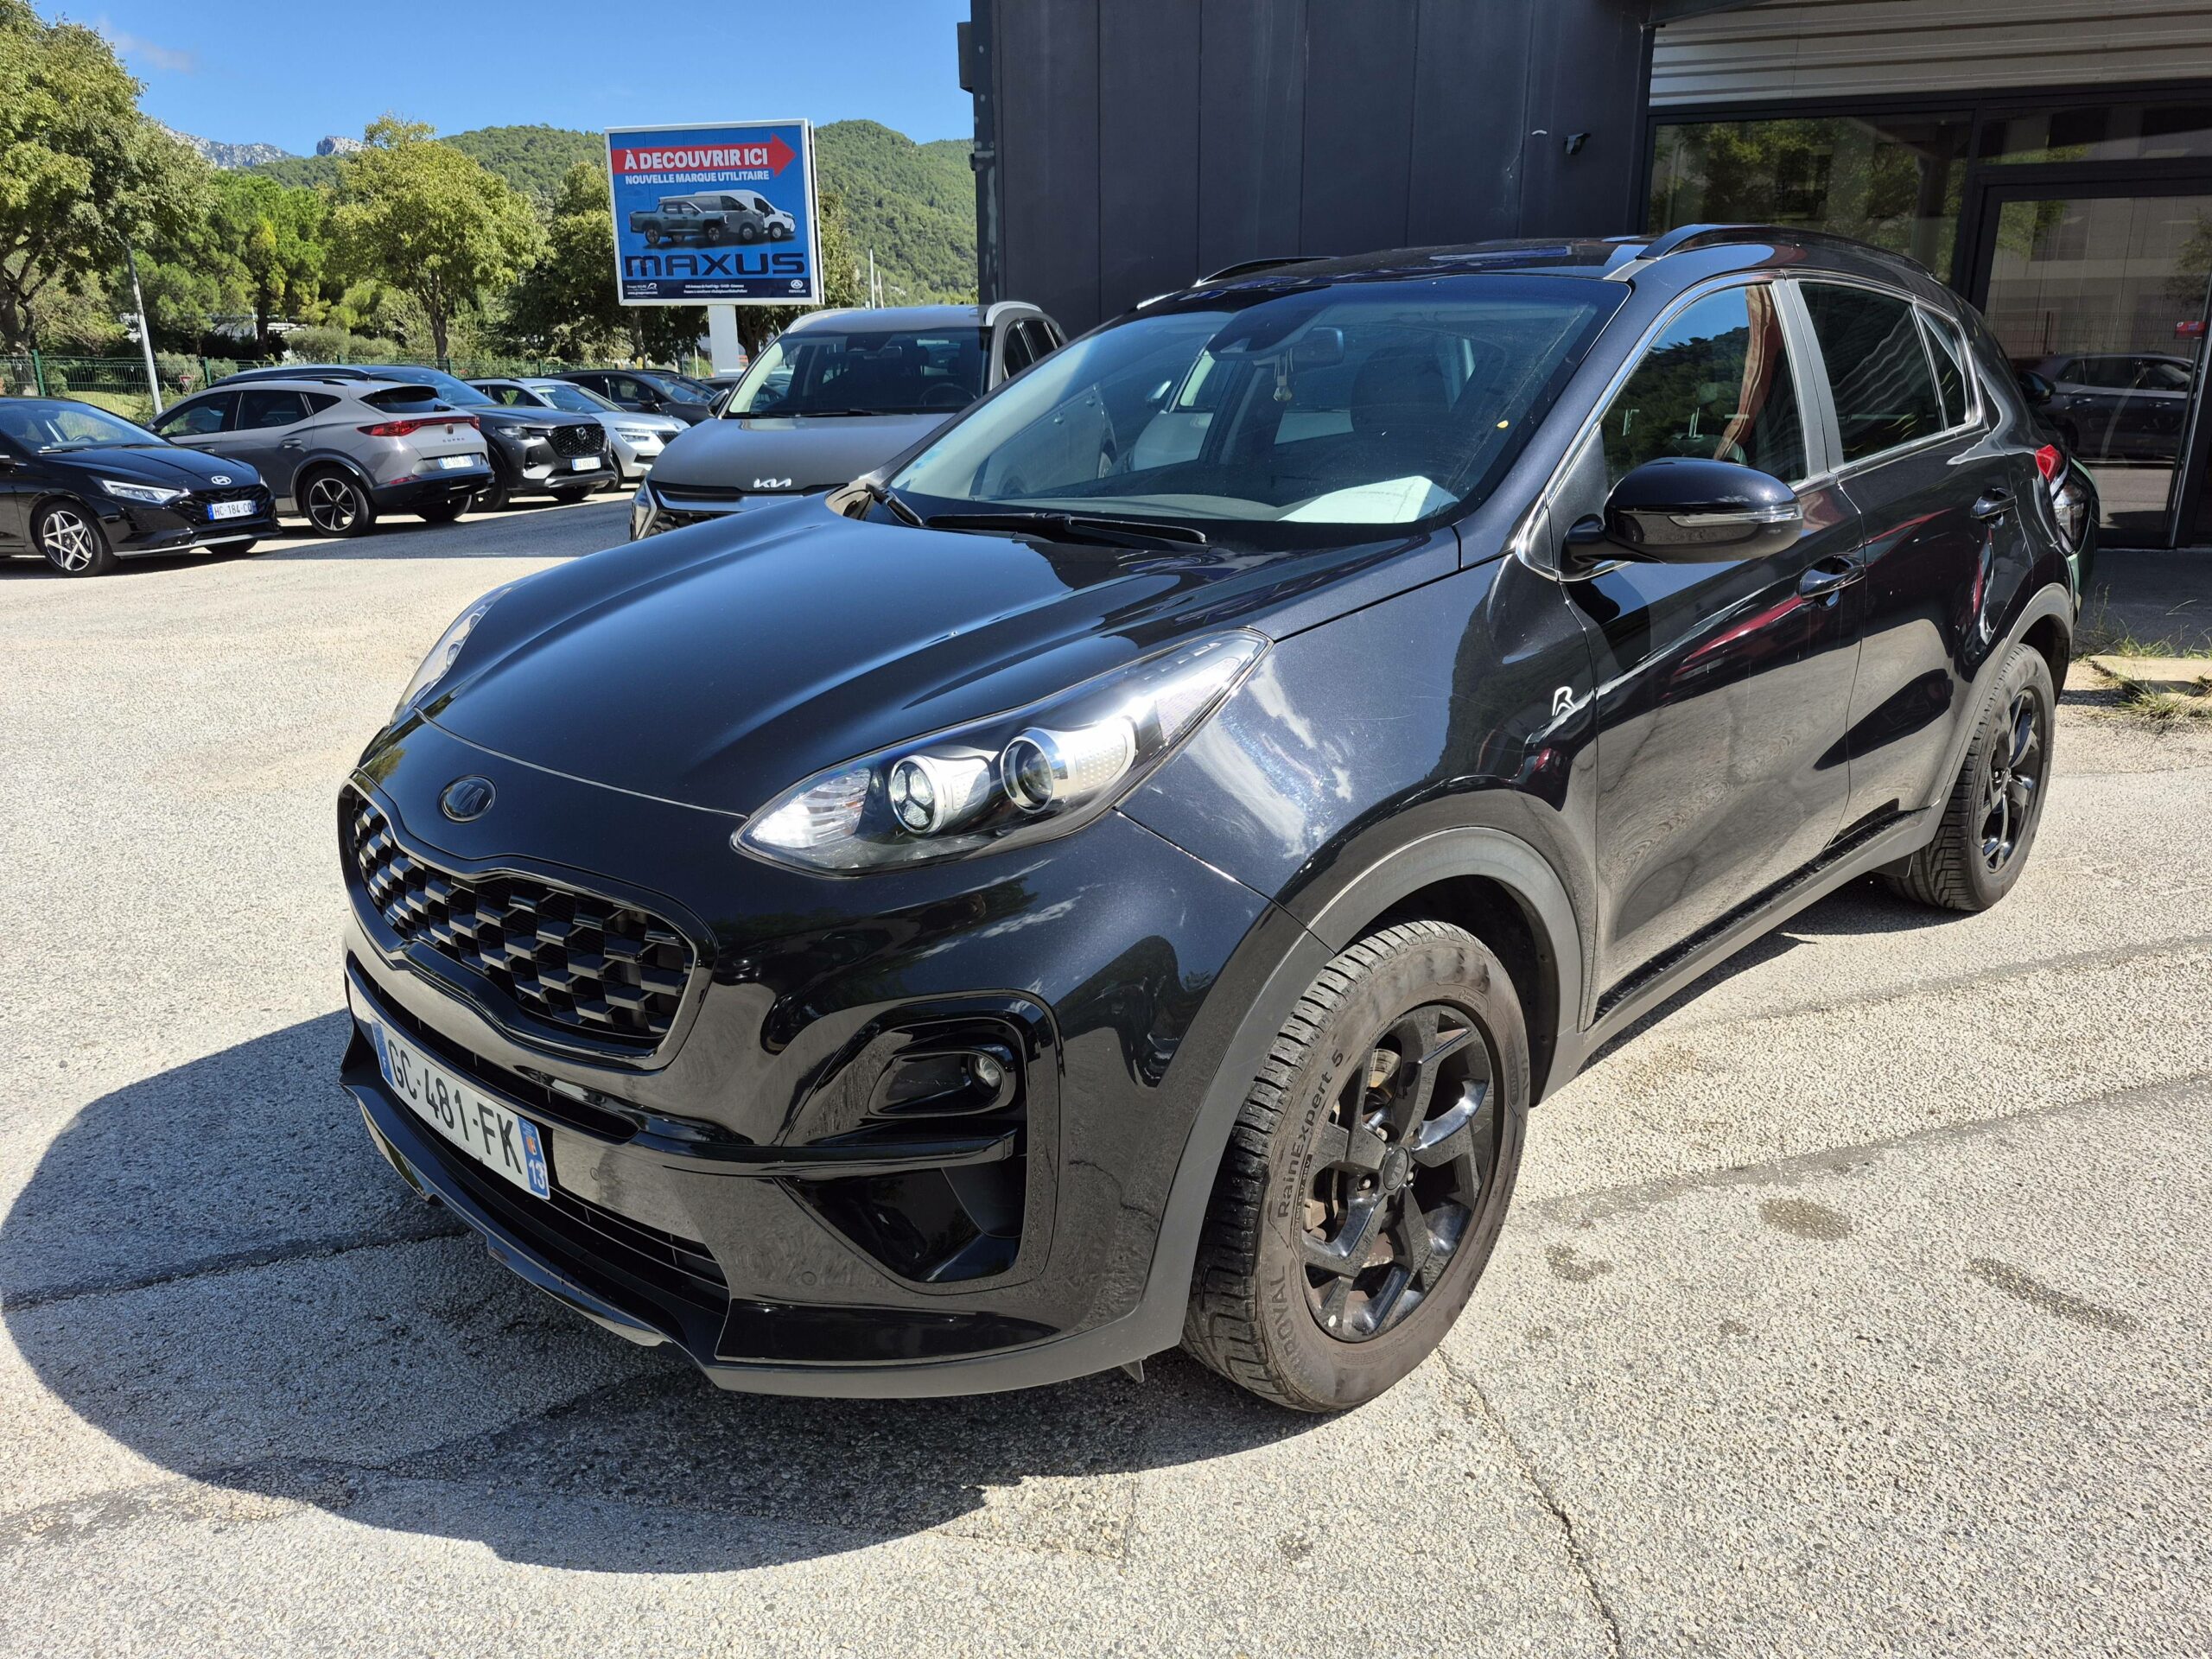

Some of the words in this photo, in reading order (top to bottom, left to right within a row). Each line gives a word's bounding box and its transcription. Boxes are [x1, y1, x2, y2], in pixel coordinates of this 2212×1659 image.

[624, 149, 638, 170] À
[639, 149, 742, 169] DECOUVRIR
[744, 148, 769, 166] ICI
[625, 173, 675, 185] NOUVELLE
[676, 172, 717, 184] MARQUE
[717, 170, 770, 182] UTILITAIRE
[625, 253, 804, 276] MAXUS
[388, 1039, 523, 1175] GC-481-FK
[1276, 1071, 1332, 1218] RainExpert
[1331, 1048, 1344, 1068] 5
[528, 1159, 546, 1190] 13
